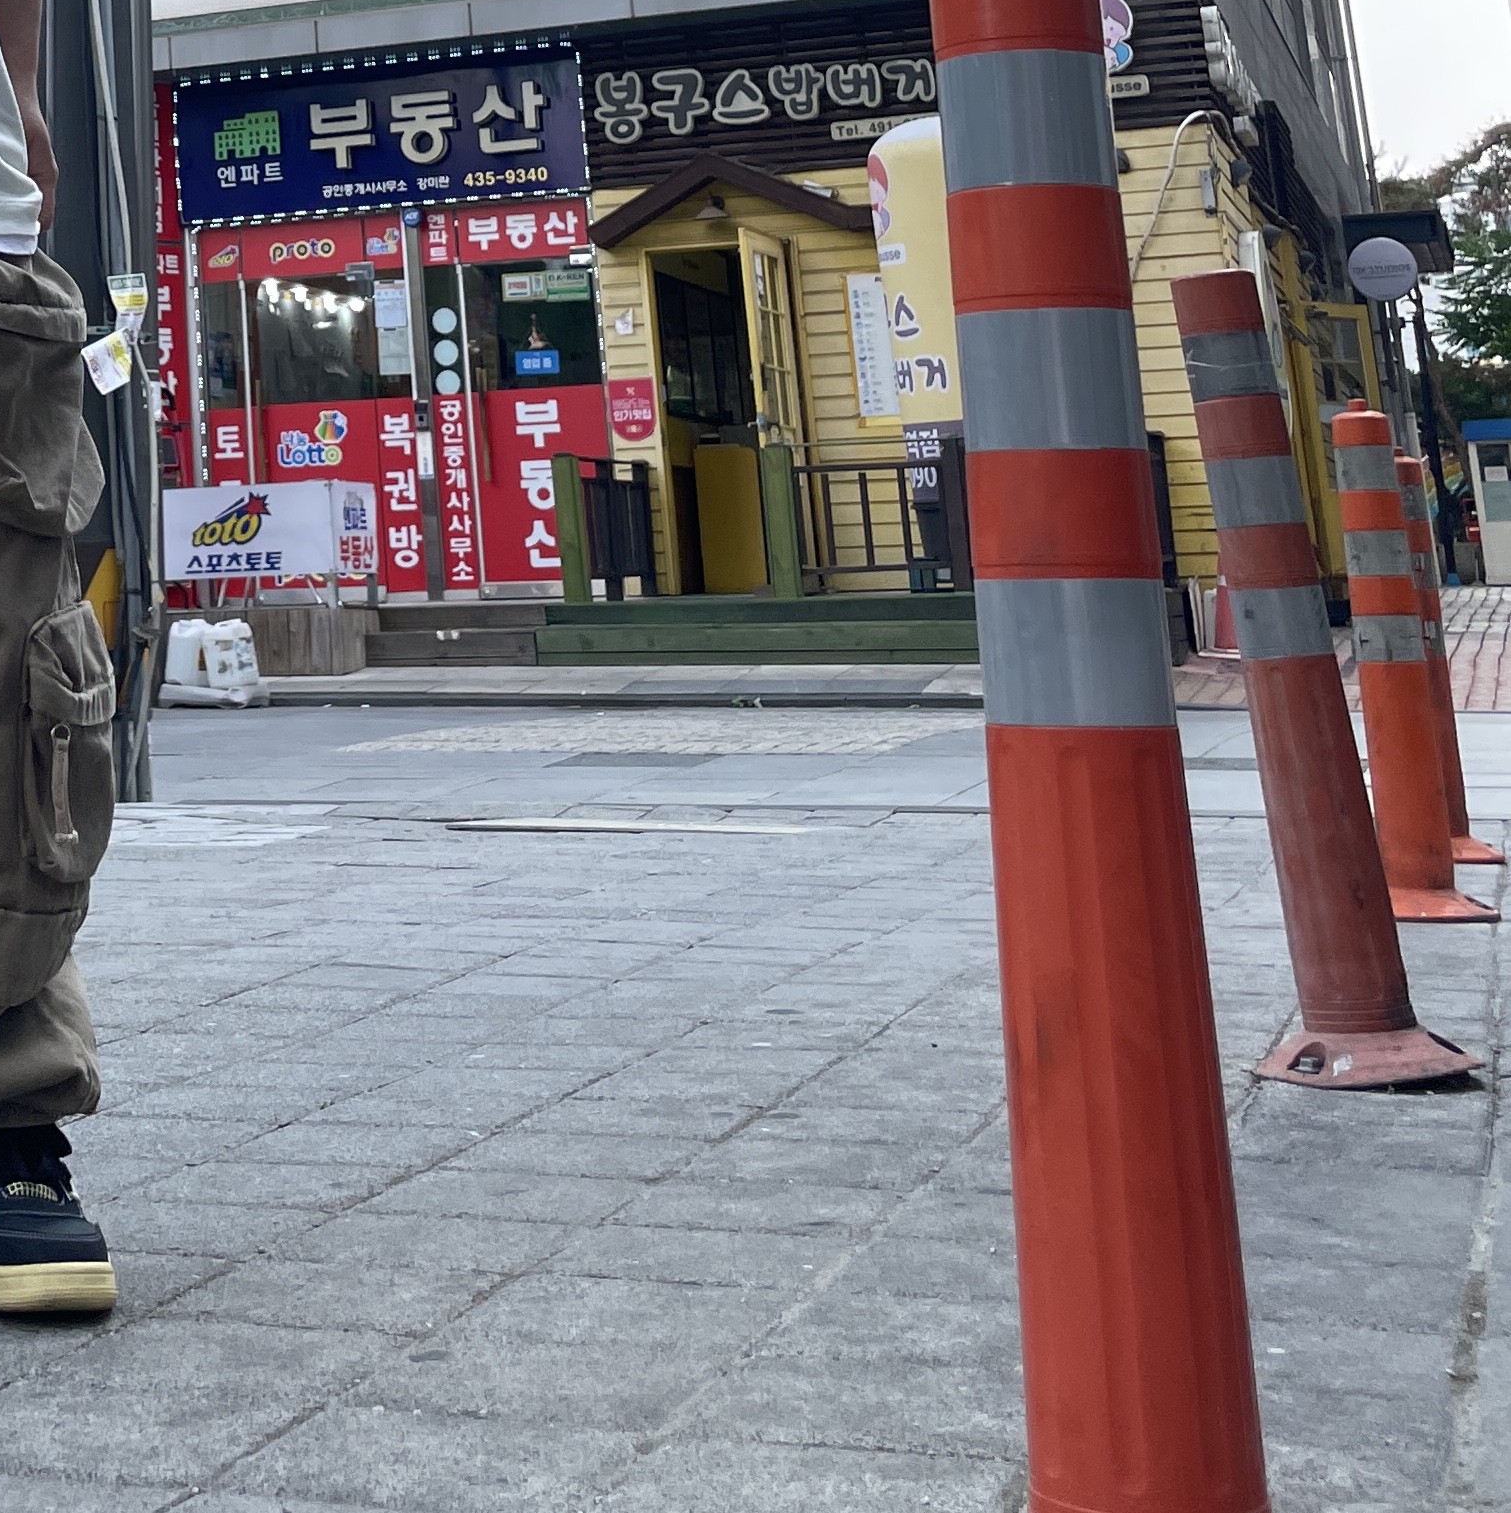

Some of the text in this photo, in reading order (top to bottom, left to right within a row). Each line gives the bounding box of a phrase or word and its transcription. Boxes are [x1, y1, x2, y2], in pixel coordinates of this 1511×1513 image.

[595, 59, 936, 145] 봉구스밥버거
[309, 80, 546, 169] 부동산
[836, 125, 865, 137] Tel.
[217, 162, 284, 189] 엔파트
[464, 167, 548, 188] 435-9340
[468, 210, 578, 251] 부동산
[270, 238, 335, 263] proto
[278, 444, 342, 466] Lotto
[380, 412, 423, 568] 복권방
[440, 399, 475, 581] 공인중개사사무소
[192, 513, 261, 547] toto
[185, 550, 283, 574] 스포츠토토
